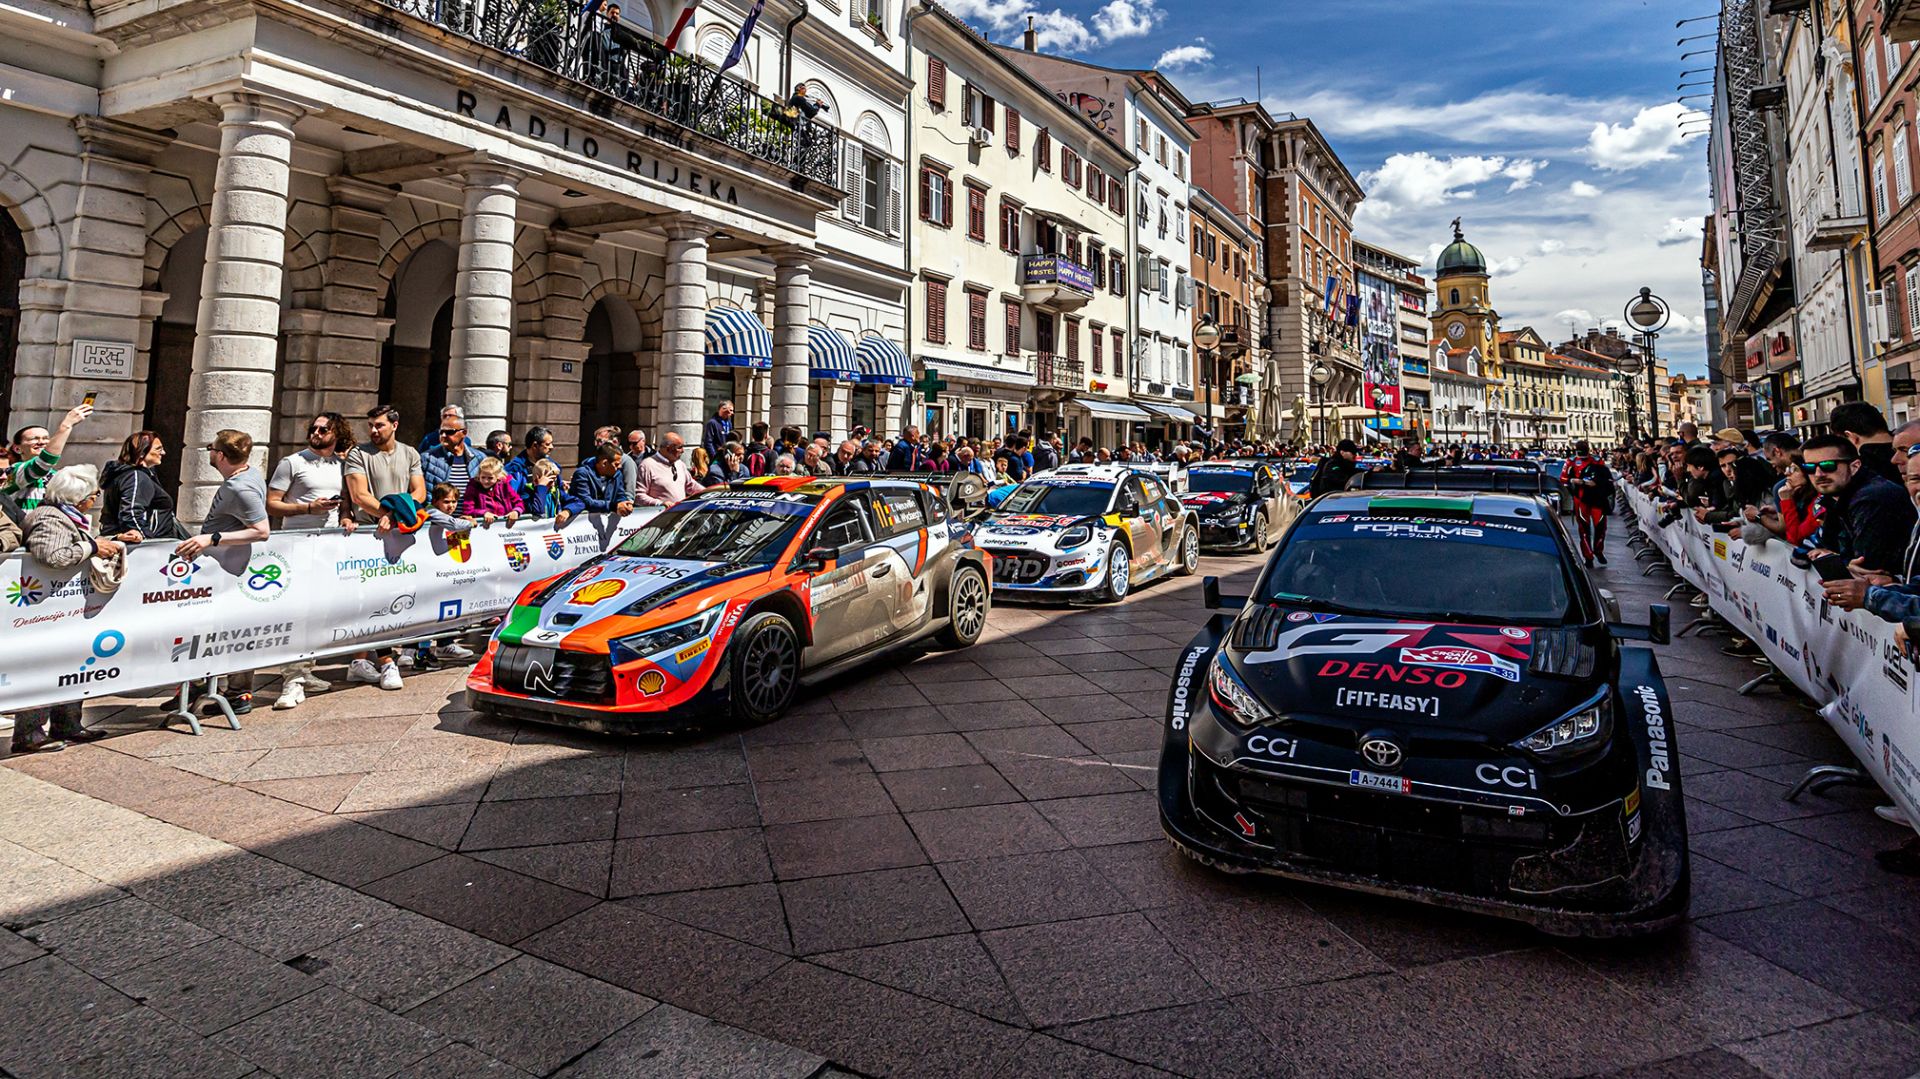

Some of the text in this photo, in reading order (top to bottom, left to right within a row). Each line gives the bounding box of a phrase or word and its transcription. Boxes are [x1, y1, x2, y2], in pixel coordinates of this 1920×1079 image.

[457, 90, 739, 205] RADIO RIJEKA
[1059, 266, 1092, 285] HAPPY HOSTEL
[1353, 524, 1483, 537] FORUM8
[1472, 520, 1527, 532] Racing
[360, 561, 417, 583] goranska
[611, 564, 690, 579] MOBIS
[143, 587, 213, 604] KARLOVAC
[205, 622, 293, 643] HRVATSKE
[202, 636, 290, 657] AUTOCESTE
[679, 642, 709, 661] PIRELLI
[58, 666, 120, 687] mireo
[1317, 660, 1467, 688] DENSO
[1502, 669, 1515, 679] 33
[1172, 646, 1209, 730] Panasonic
[1336, 687, 1439, 717] [FIT-EASY]
[1247, 735, 1298, 758] CCi
[1633, 685, 1671, 791] Panasonic
[1362, 775, 1399, 789] A-7444
[1475, 763, 1537, 790] CCi
